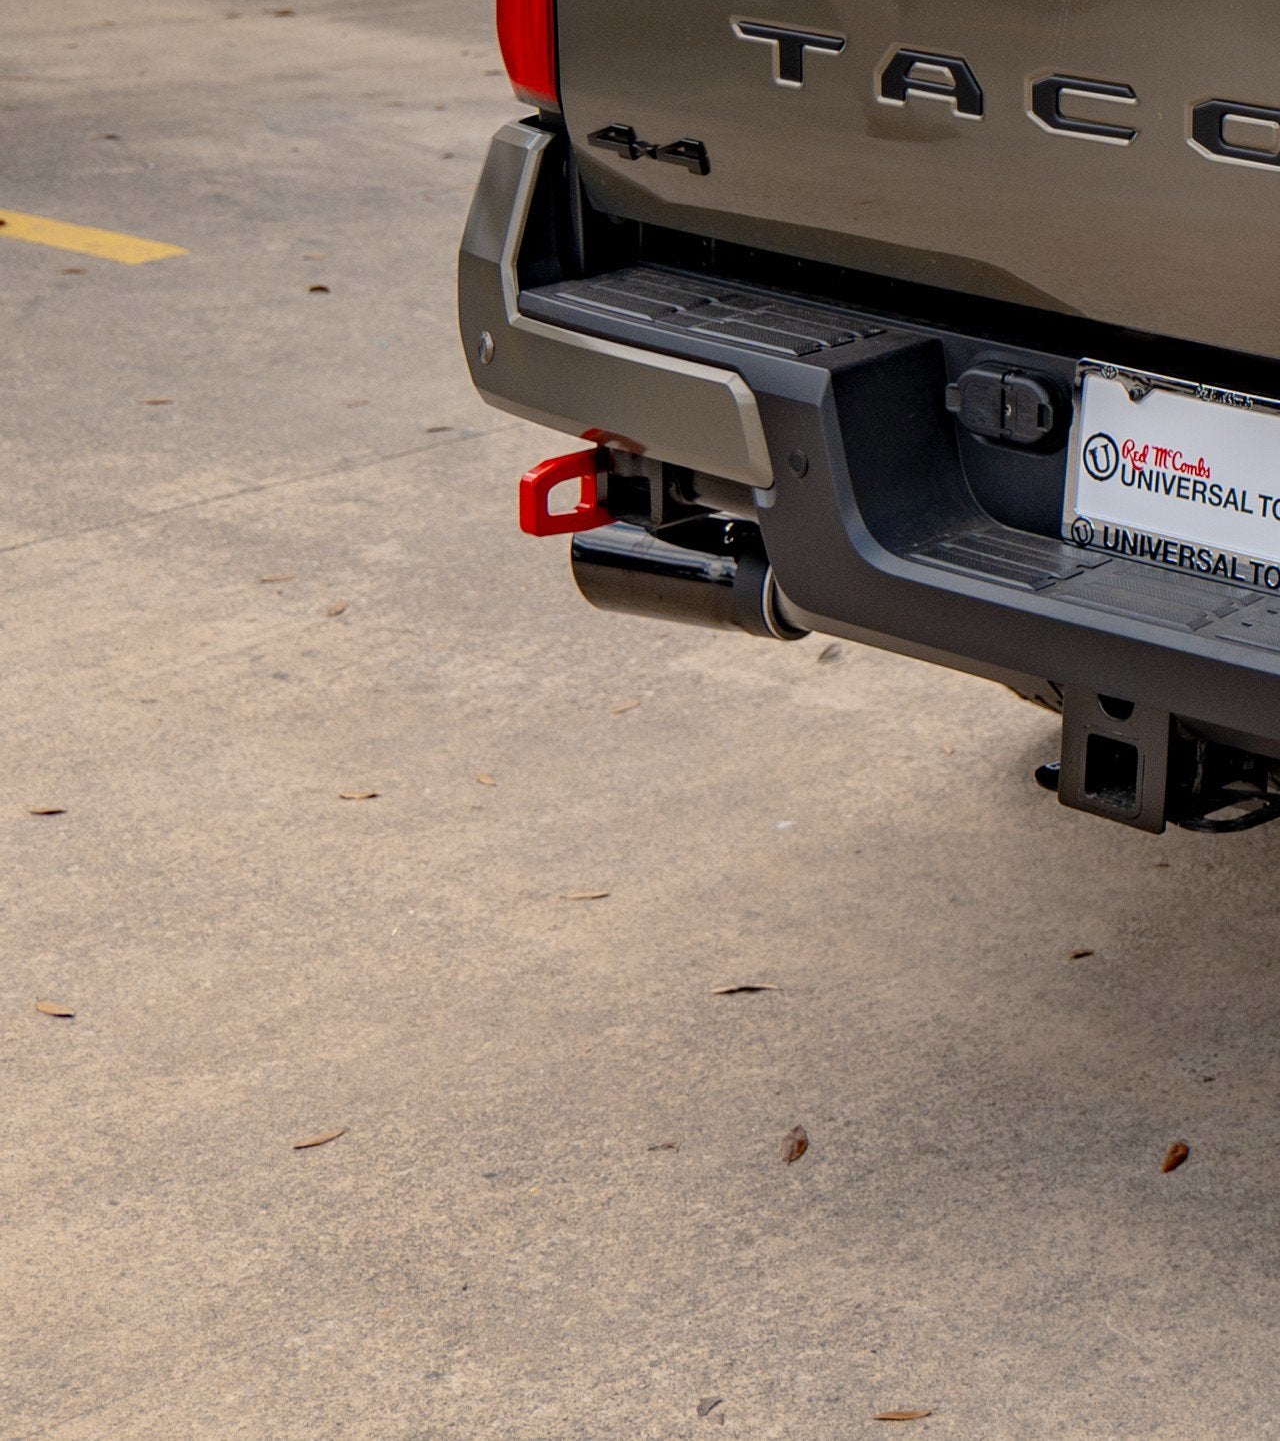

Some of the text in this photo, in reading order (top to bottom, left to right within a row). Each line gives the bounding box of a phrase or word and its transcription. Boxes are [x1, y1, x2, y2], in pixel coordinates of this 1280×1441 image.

[1121, 438, 1150, 472] Red
[1120, 462, 1254, 515] UNIVERSAL
[1102, 525, 1246, 583] UNIVERSAL
